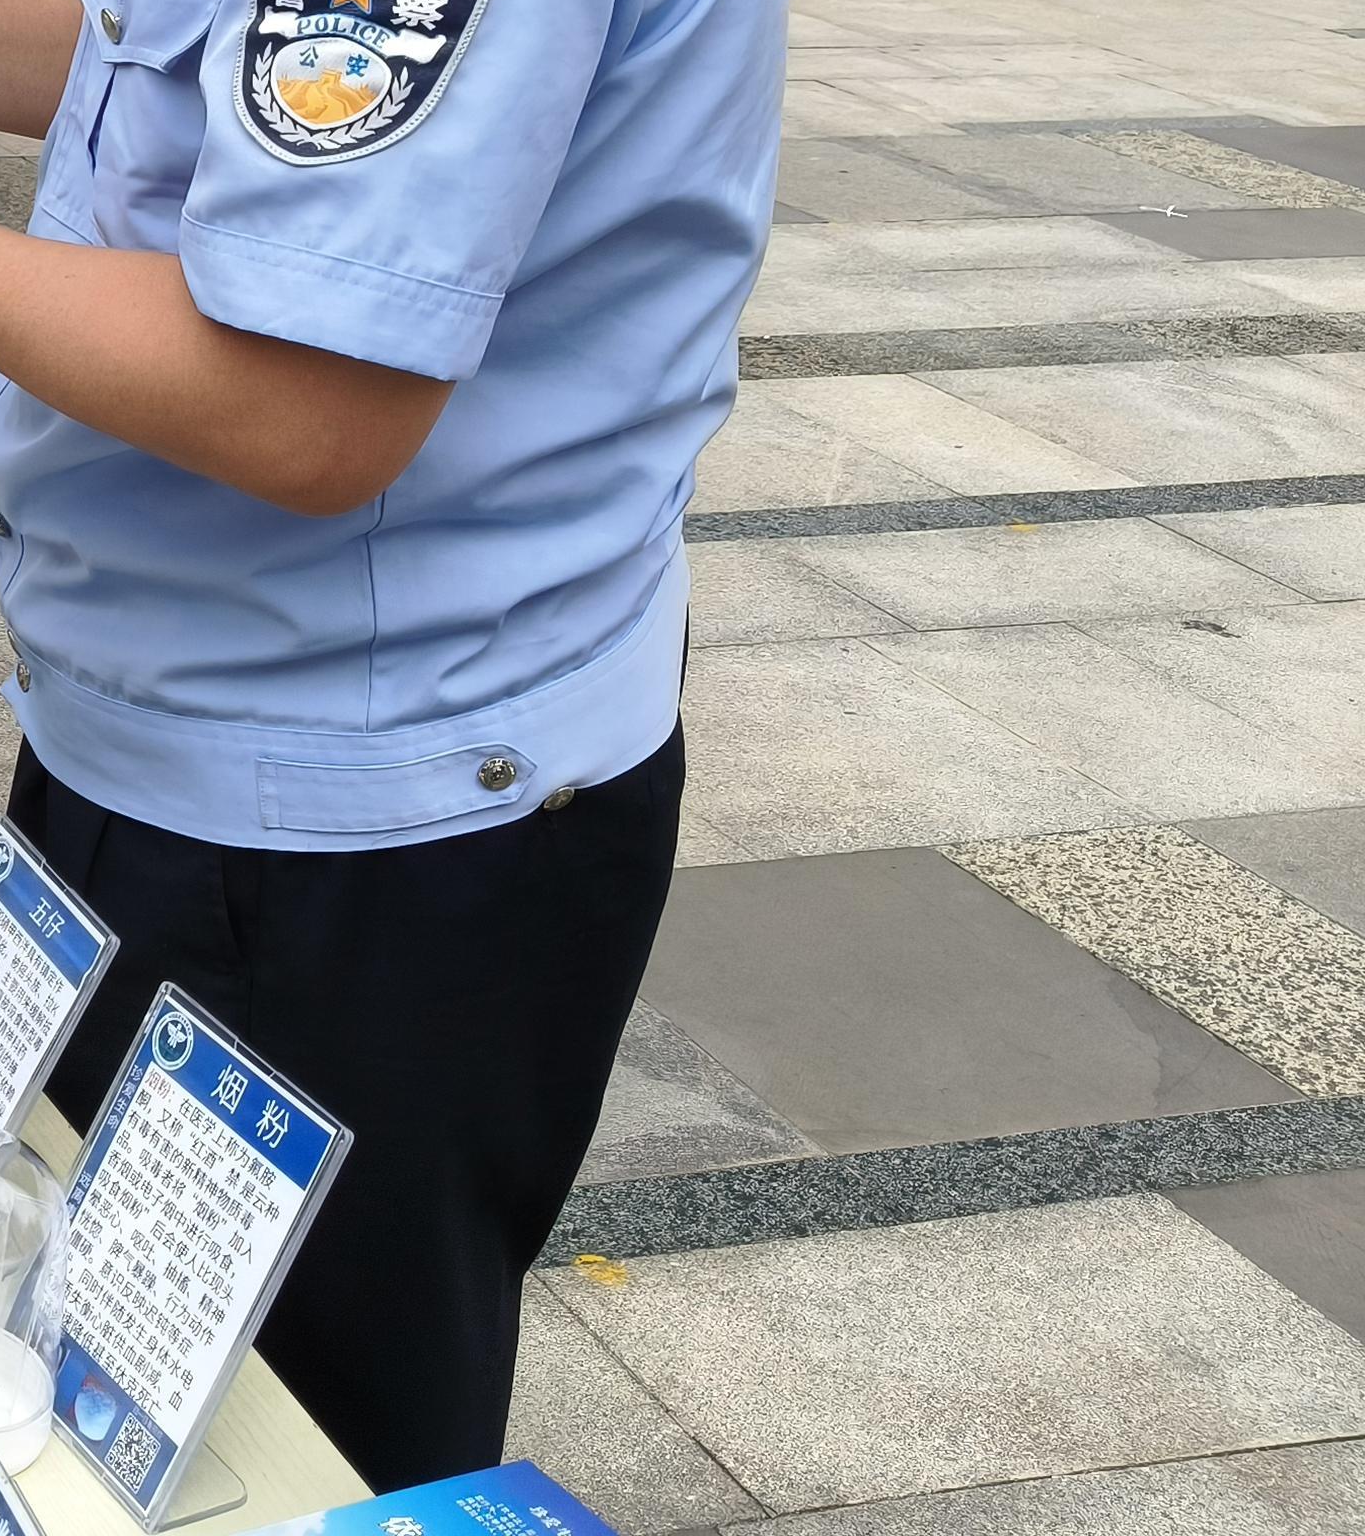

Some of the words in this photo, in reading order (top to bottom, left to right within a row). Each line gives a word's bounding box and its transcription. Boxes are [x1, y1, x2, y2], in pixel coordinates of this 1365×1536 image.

[296, 14, 388, 50] POLICE
[27, 895, 66, 939] 五仔
[209, 1062, 292, 1151] 烟粉
[104, 1149, 241, 1280] 香烟或电子烟中进行吸食，
[123, 1108, 257, 1233] 有毒有害的新精神物质毒
